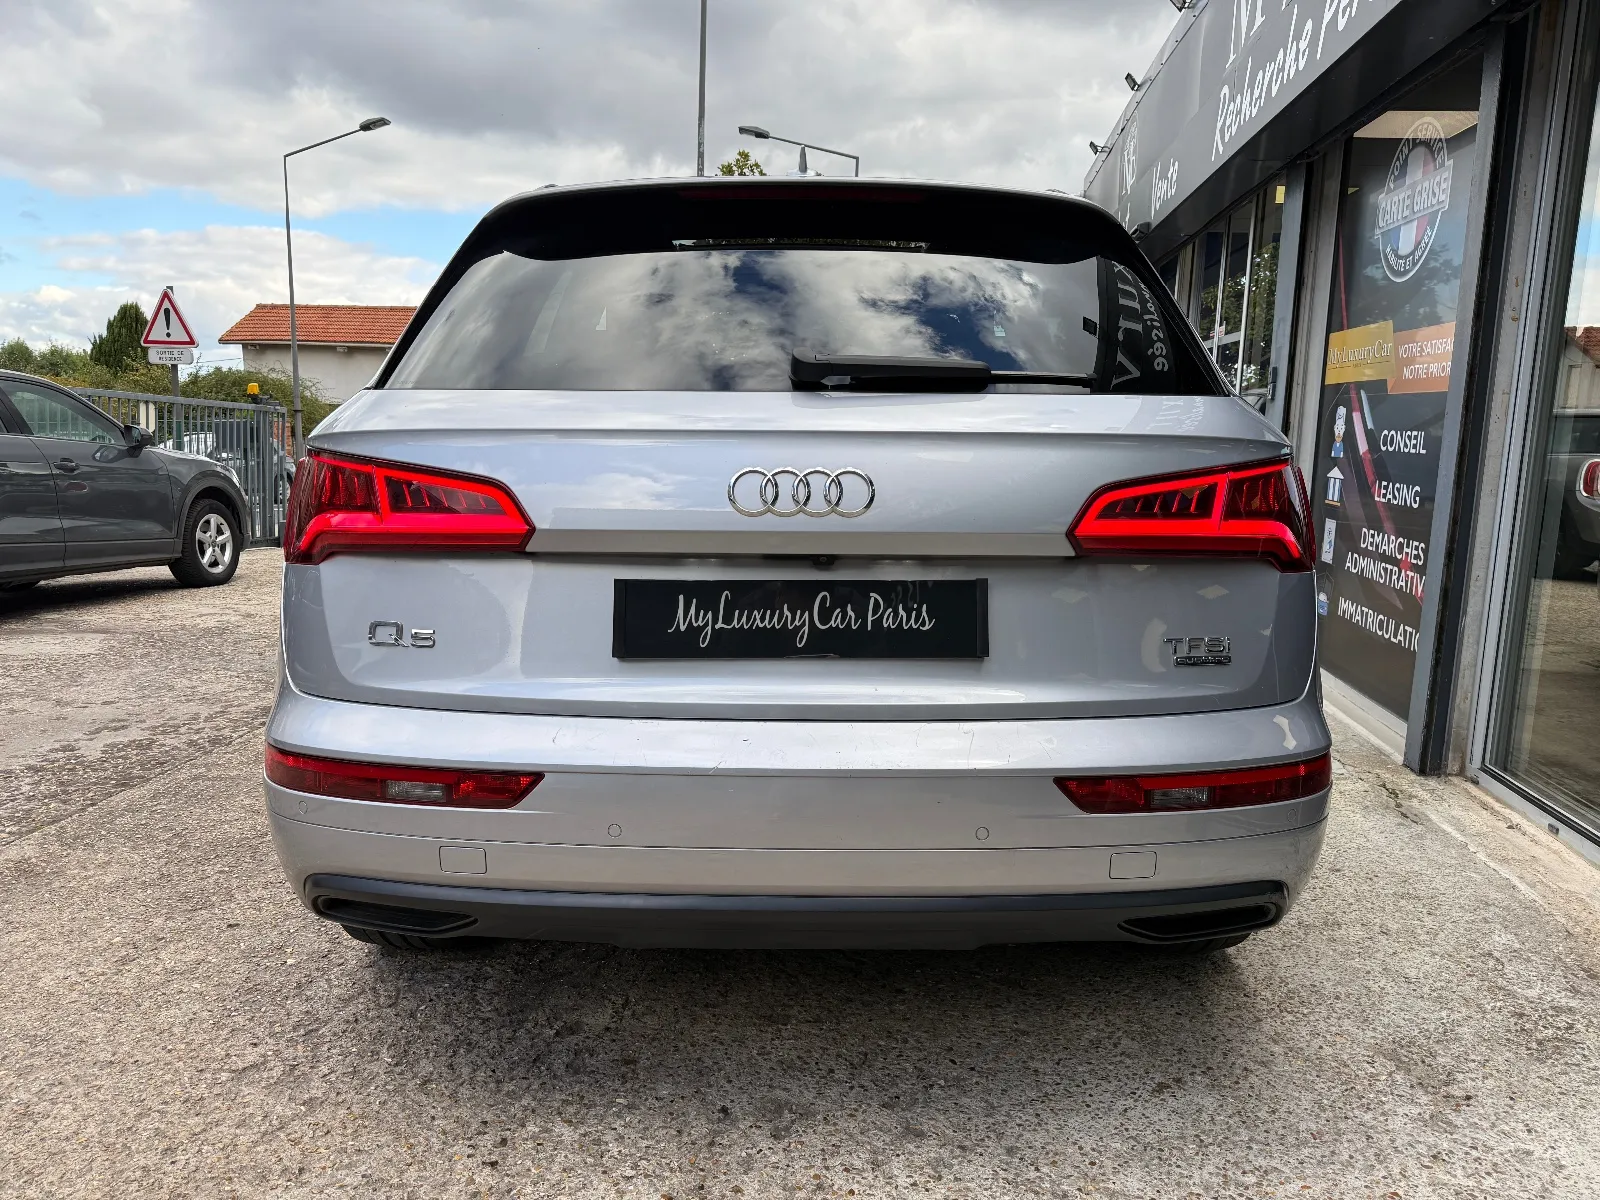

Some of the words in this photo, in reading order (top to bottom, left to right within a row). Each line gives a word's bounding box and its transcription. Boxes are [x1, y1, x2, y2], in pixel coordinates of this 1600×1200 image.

[1151, 158, 1179, 220] Vente
[1212, 4, 1313, 161] Recherche
[1389, 132, 1414, 190] POINT
[1416, 123, 1444, 169] SERVICE
[1378, 189, 1412, 228] CARTE
[1413, 171, 1449, 213] GRISE
[1398, 342, 1422, 358] VOTRE
[1402, 364, 1428, 379] NOTRE
[1428, 362, 1452, 379] PRIOR
[1380, 429, 1427, 454] CONSEIL
[1374, 480, 1421, 509] LEASING
[1360, 527, 1426, 566] DEMARCHES
[1345, 551, 1426, 598] ADMINISTRATIV
[867, 592, 936, 631] Paris
[368, 620, 436, 648] Q5
